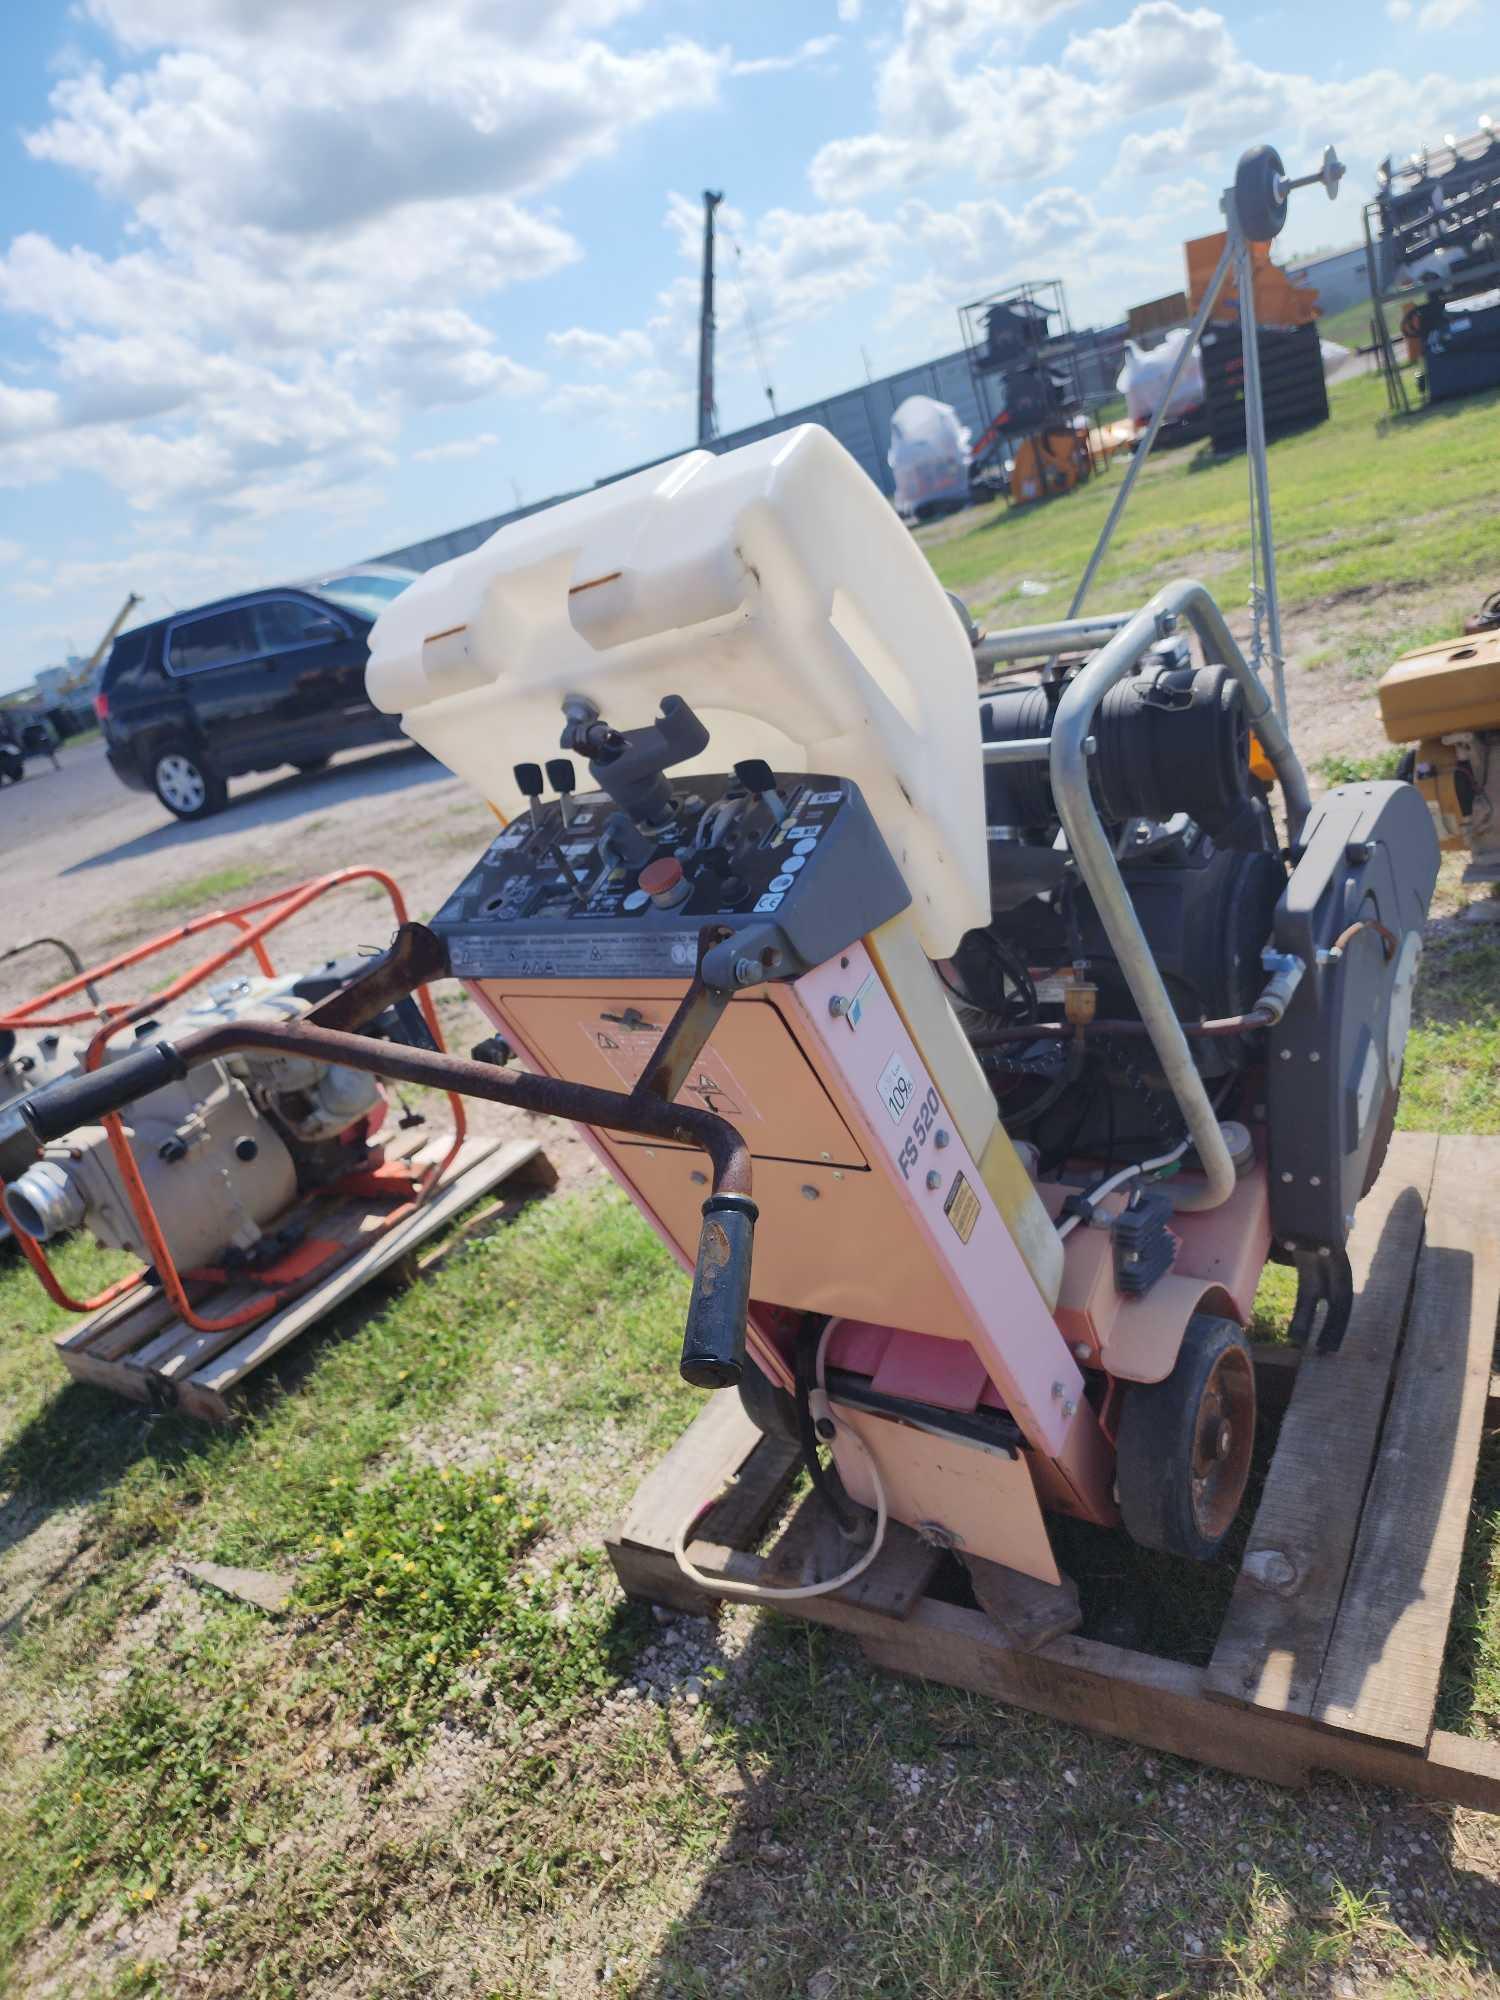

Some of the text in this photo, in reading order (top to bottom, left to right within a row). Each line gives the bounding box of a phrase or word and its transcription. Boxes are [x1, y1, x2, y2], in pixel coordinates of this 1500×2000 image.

[759, 895, 780, 908] CE
[888, 1076, 909, 1117] 109
[897, 1087, 939, 1181] FS 520
